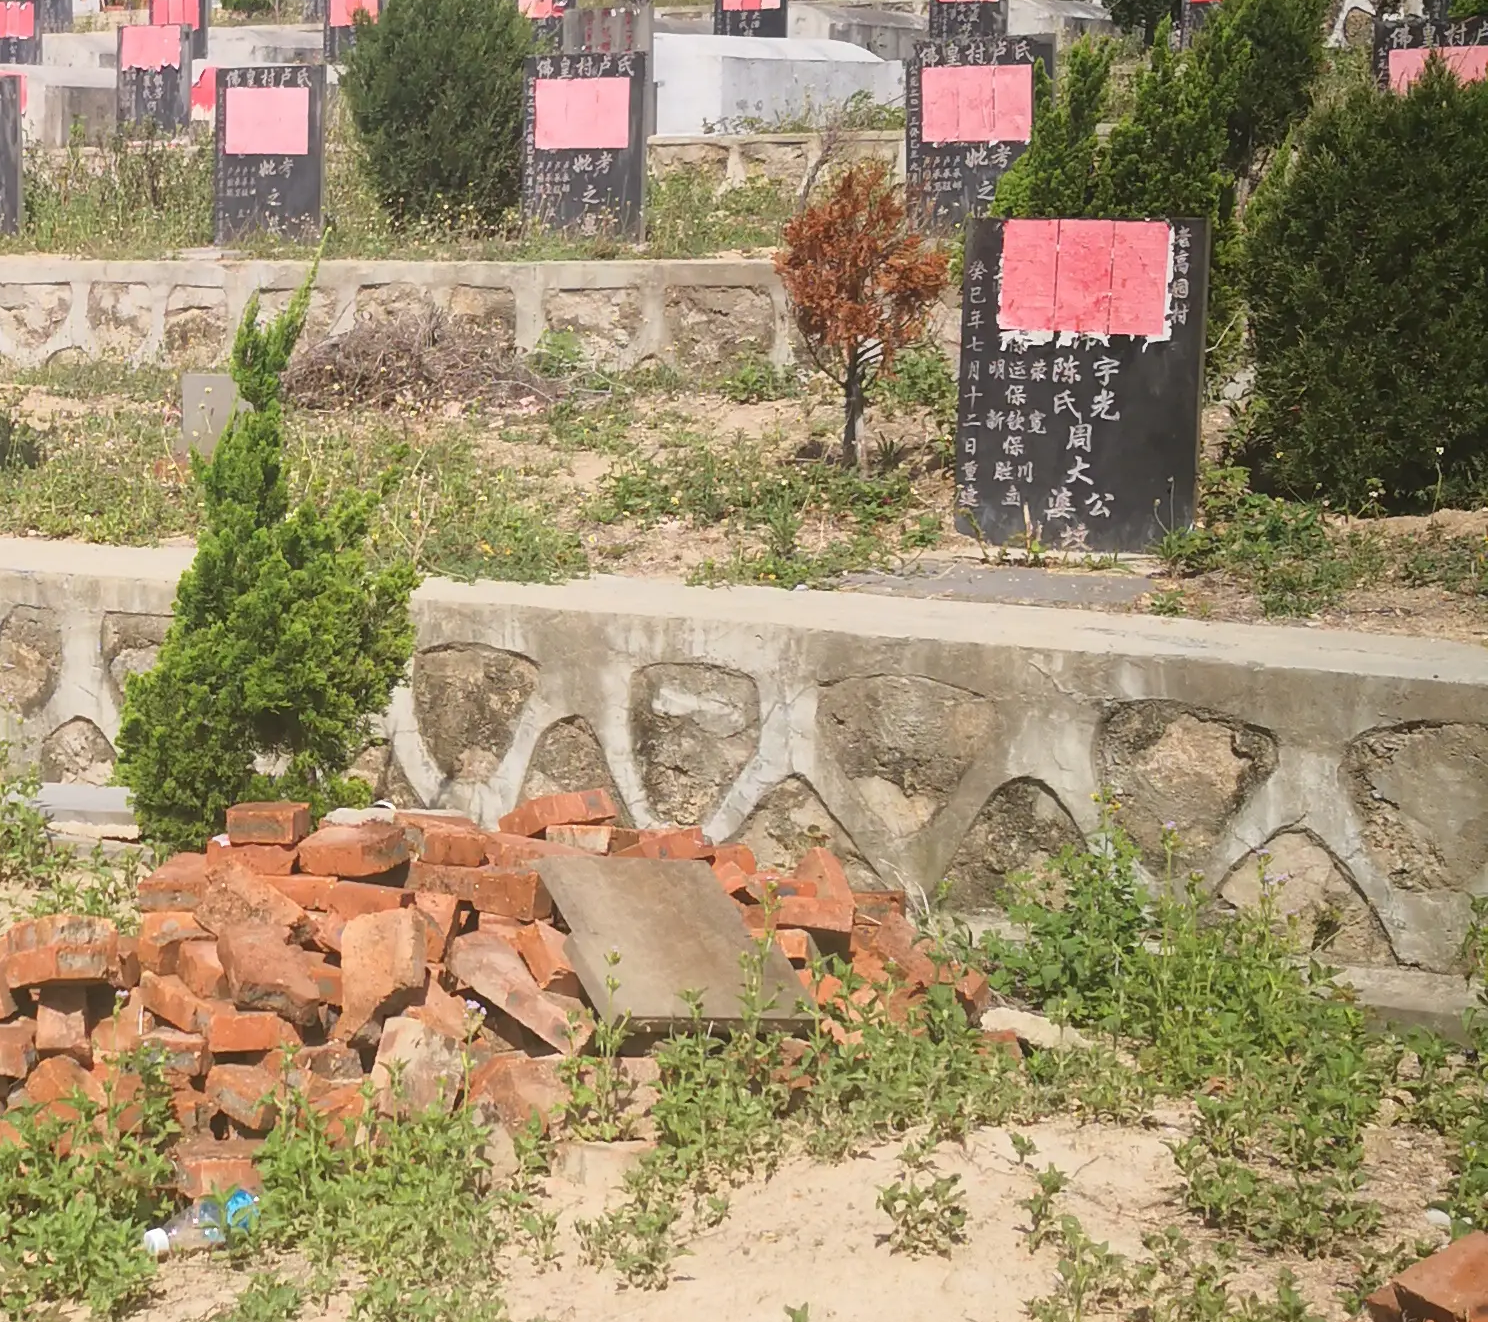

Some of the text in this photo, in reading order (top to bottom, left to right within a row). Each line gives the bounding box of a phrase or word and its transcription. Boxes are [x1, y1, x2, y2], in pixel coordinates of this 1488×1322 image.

[919, 40, 1034, 67] 佛皇村卢氏
[226, 68, 312, 88] 佛皇村卢氏
[537, 56, 635, 78] 佛皇村卢氏
